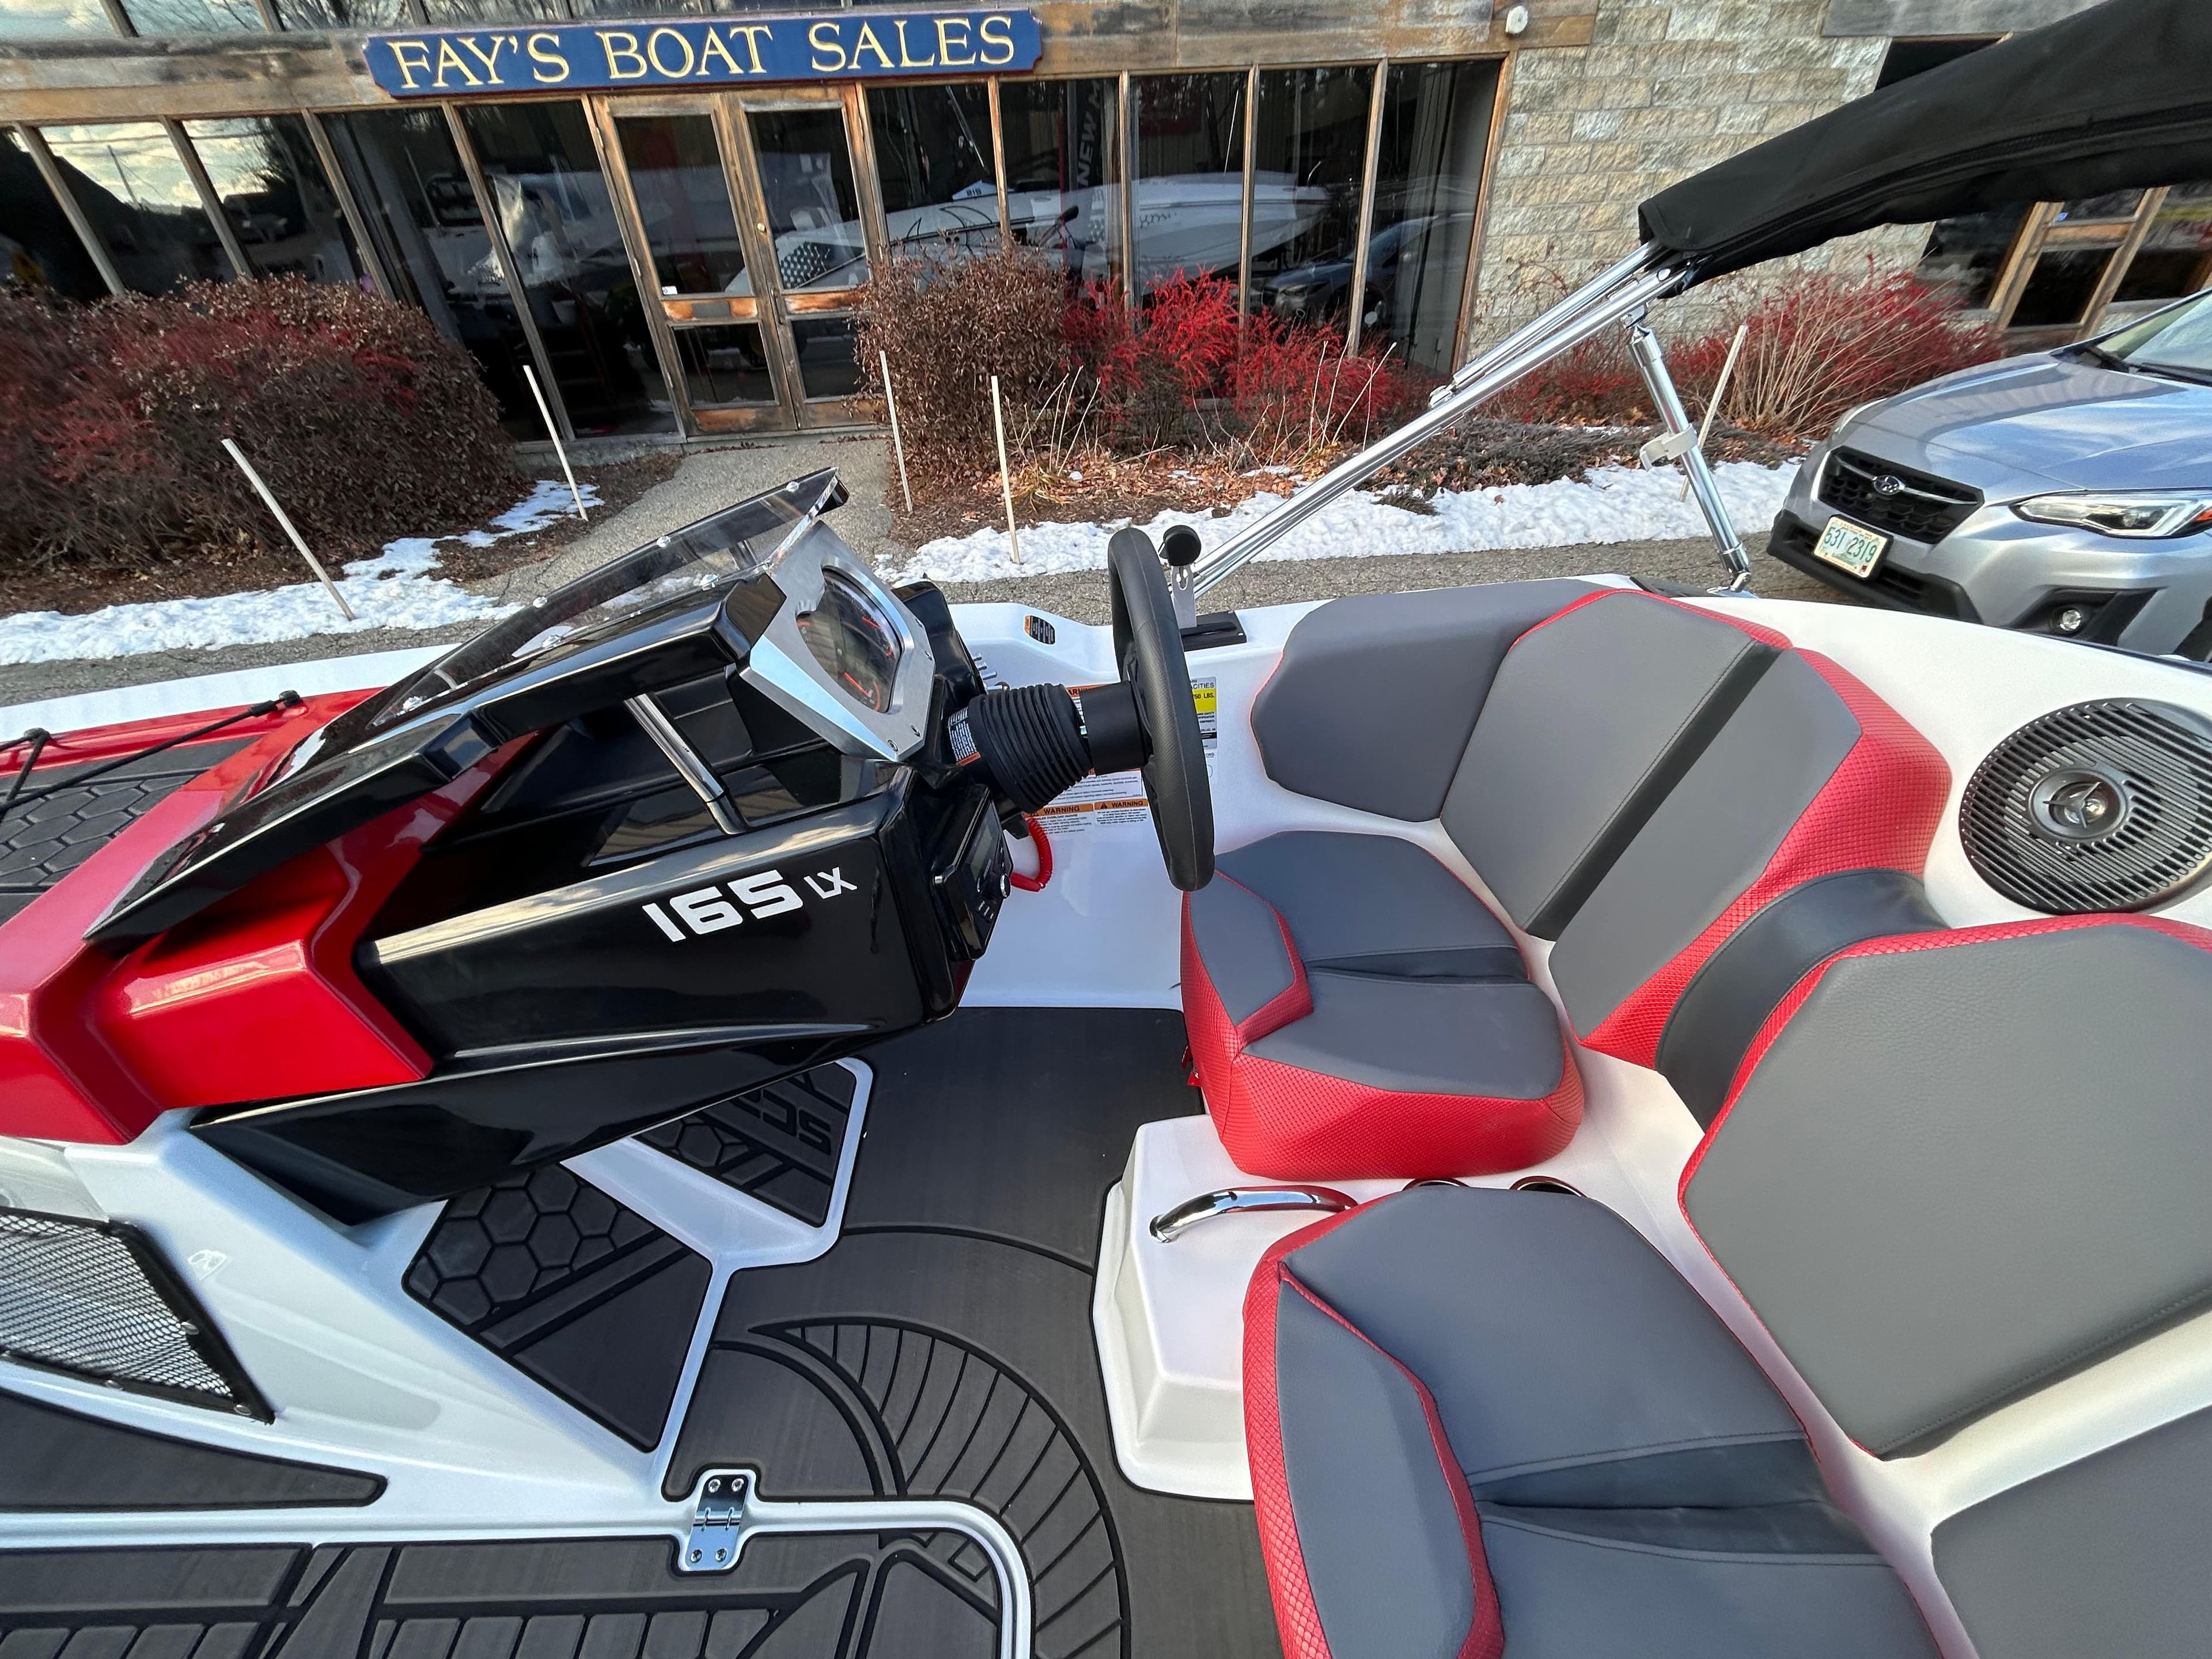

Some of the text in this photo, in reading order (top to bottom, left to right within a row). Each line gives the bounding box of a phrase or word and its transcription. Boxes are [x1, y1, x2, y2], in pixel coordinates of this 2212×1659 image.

[388, 15, 1015, 89] FAY'S BOAT SALES
[1824, 527, 1847, 549] 531
[1847, 537, 1877, 563] 2319
[1044, 806, 1080, 815] WARNING
[642, 866, 858, 942] 165 LX
